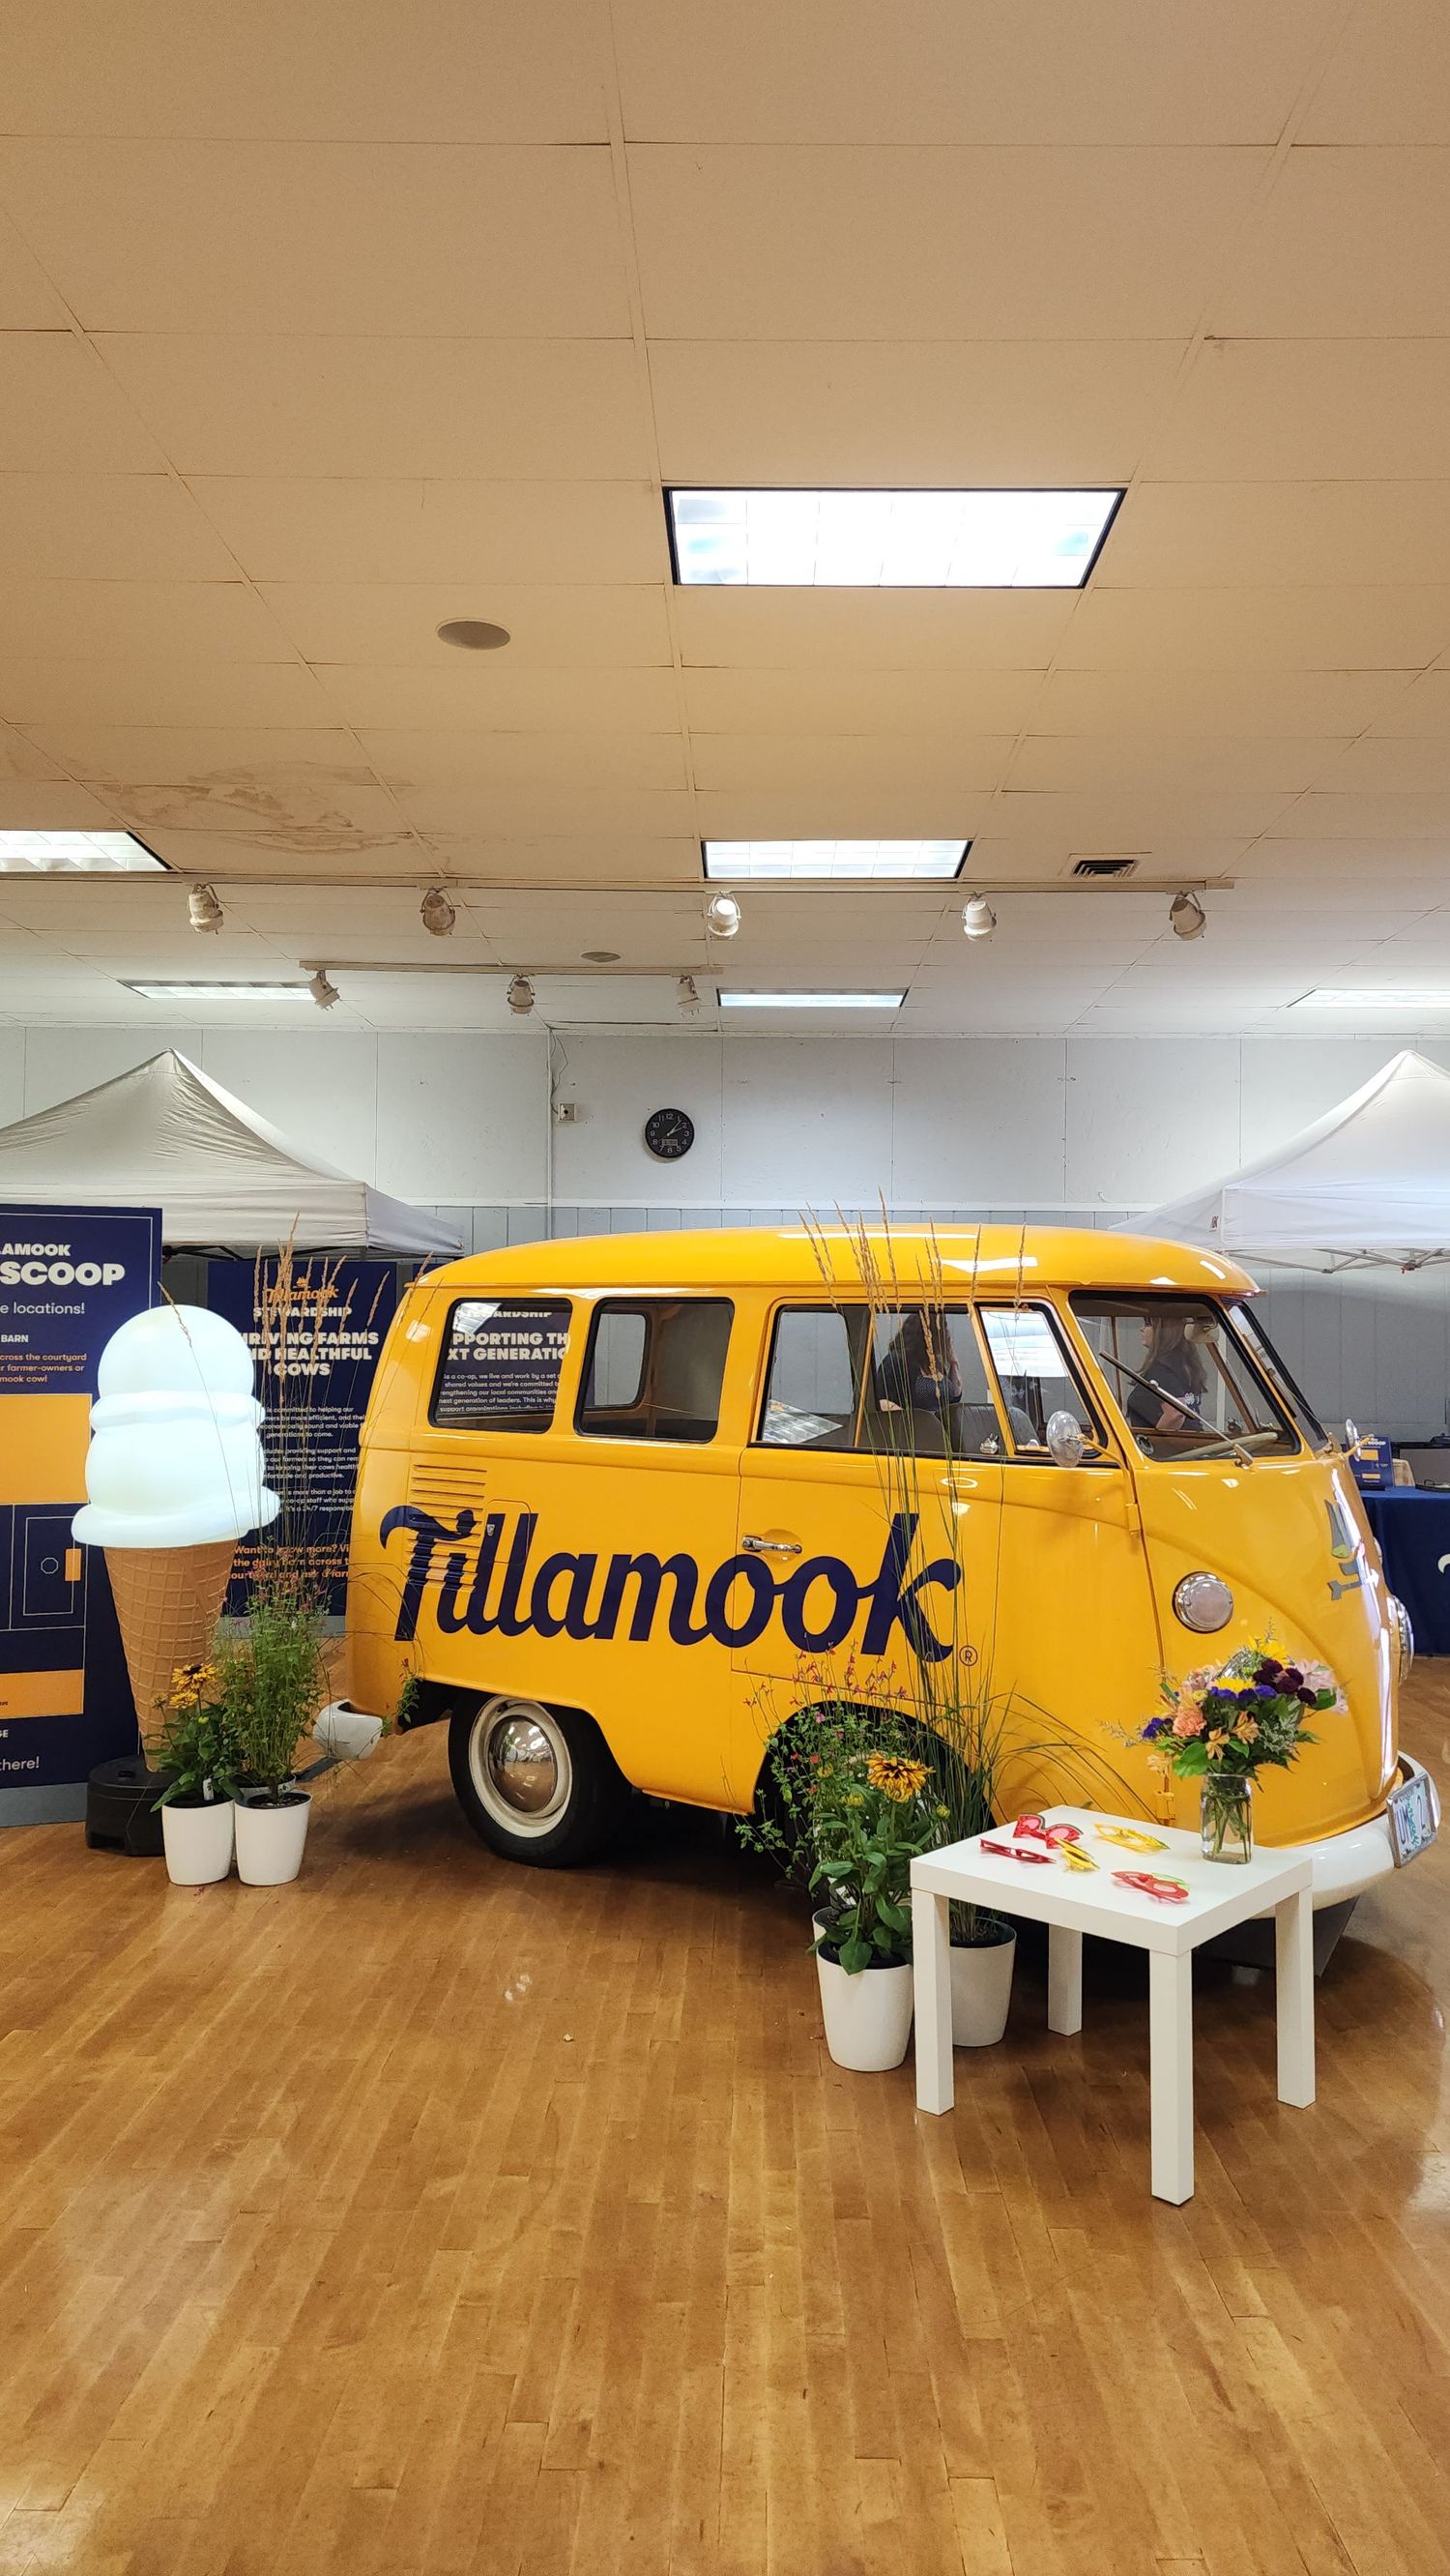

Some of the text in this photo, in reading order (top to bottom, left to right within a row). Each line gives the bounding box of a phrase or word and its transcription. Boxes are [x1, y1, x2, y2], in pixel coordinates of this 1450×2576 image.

[0, 1243, 72, 1257] AMOOK
[0, 1261, 126, 1286] SCOOP
[14, 1302, 85, 1314] locations!
[1, 1334, 29, 1343] BARN
[318, 1332, 379, 1345] FARMS
[43, 1354, 87, 1362] courtyard
[275, 1348, 372, 1361] HEALTHFUL
[274, 1363, 331, 1375] COWS
[234, 1545, 261, 1554] Want
[306, 1544, 337, 1553] more?
[233, 1558, 250, 1566] the
[380, 1506, 962, 1663] Tillamook
